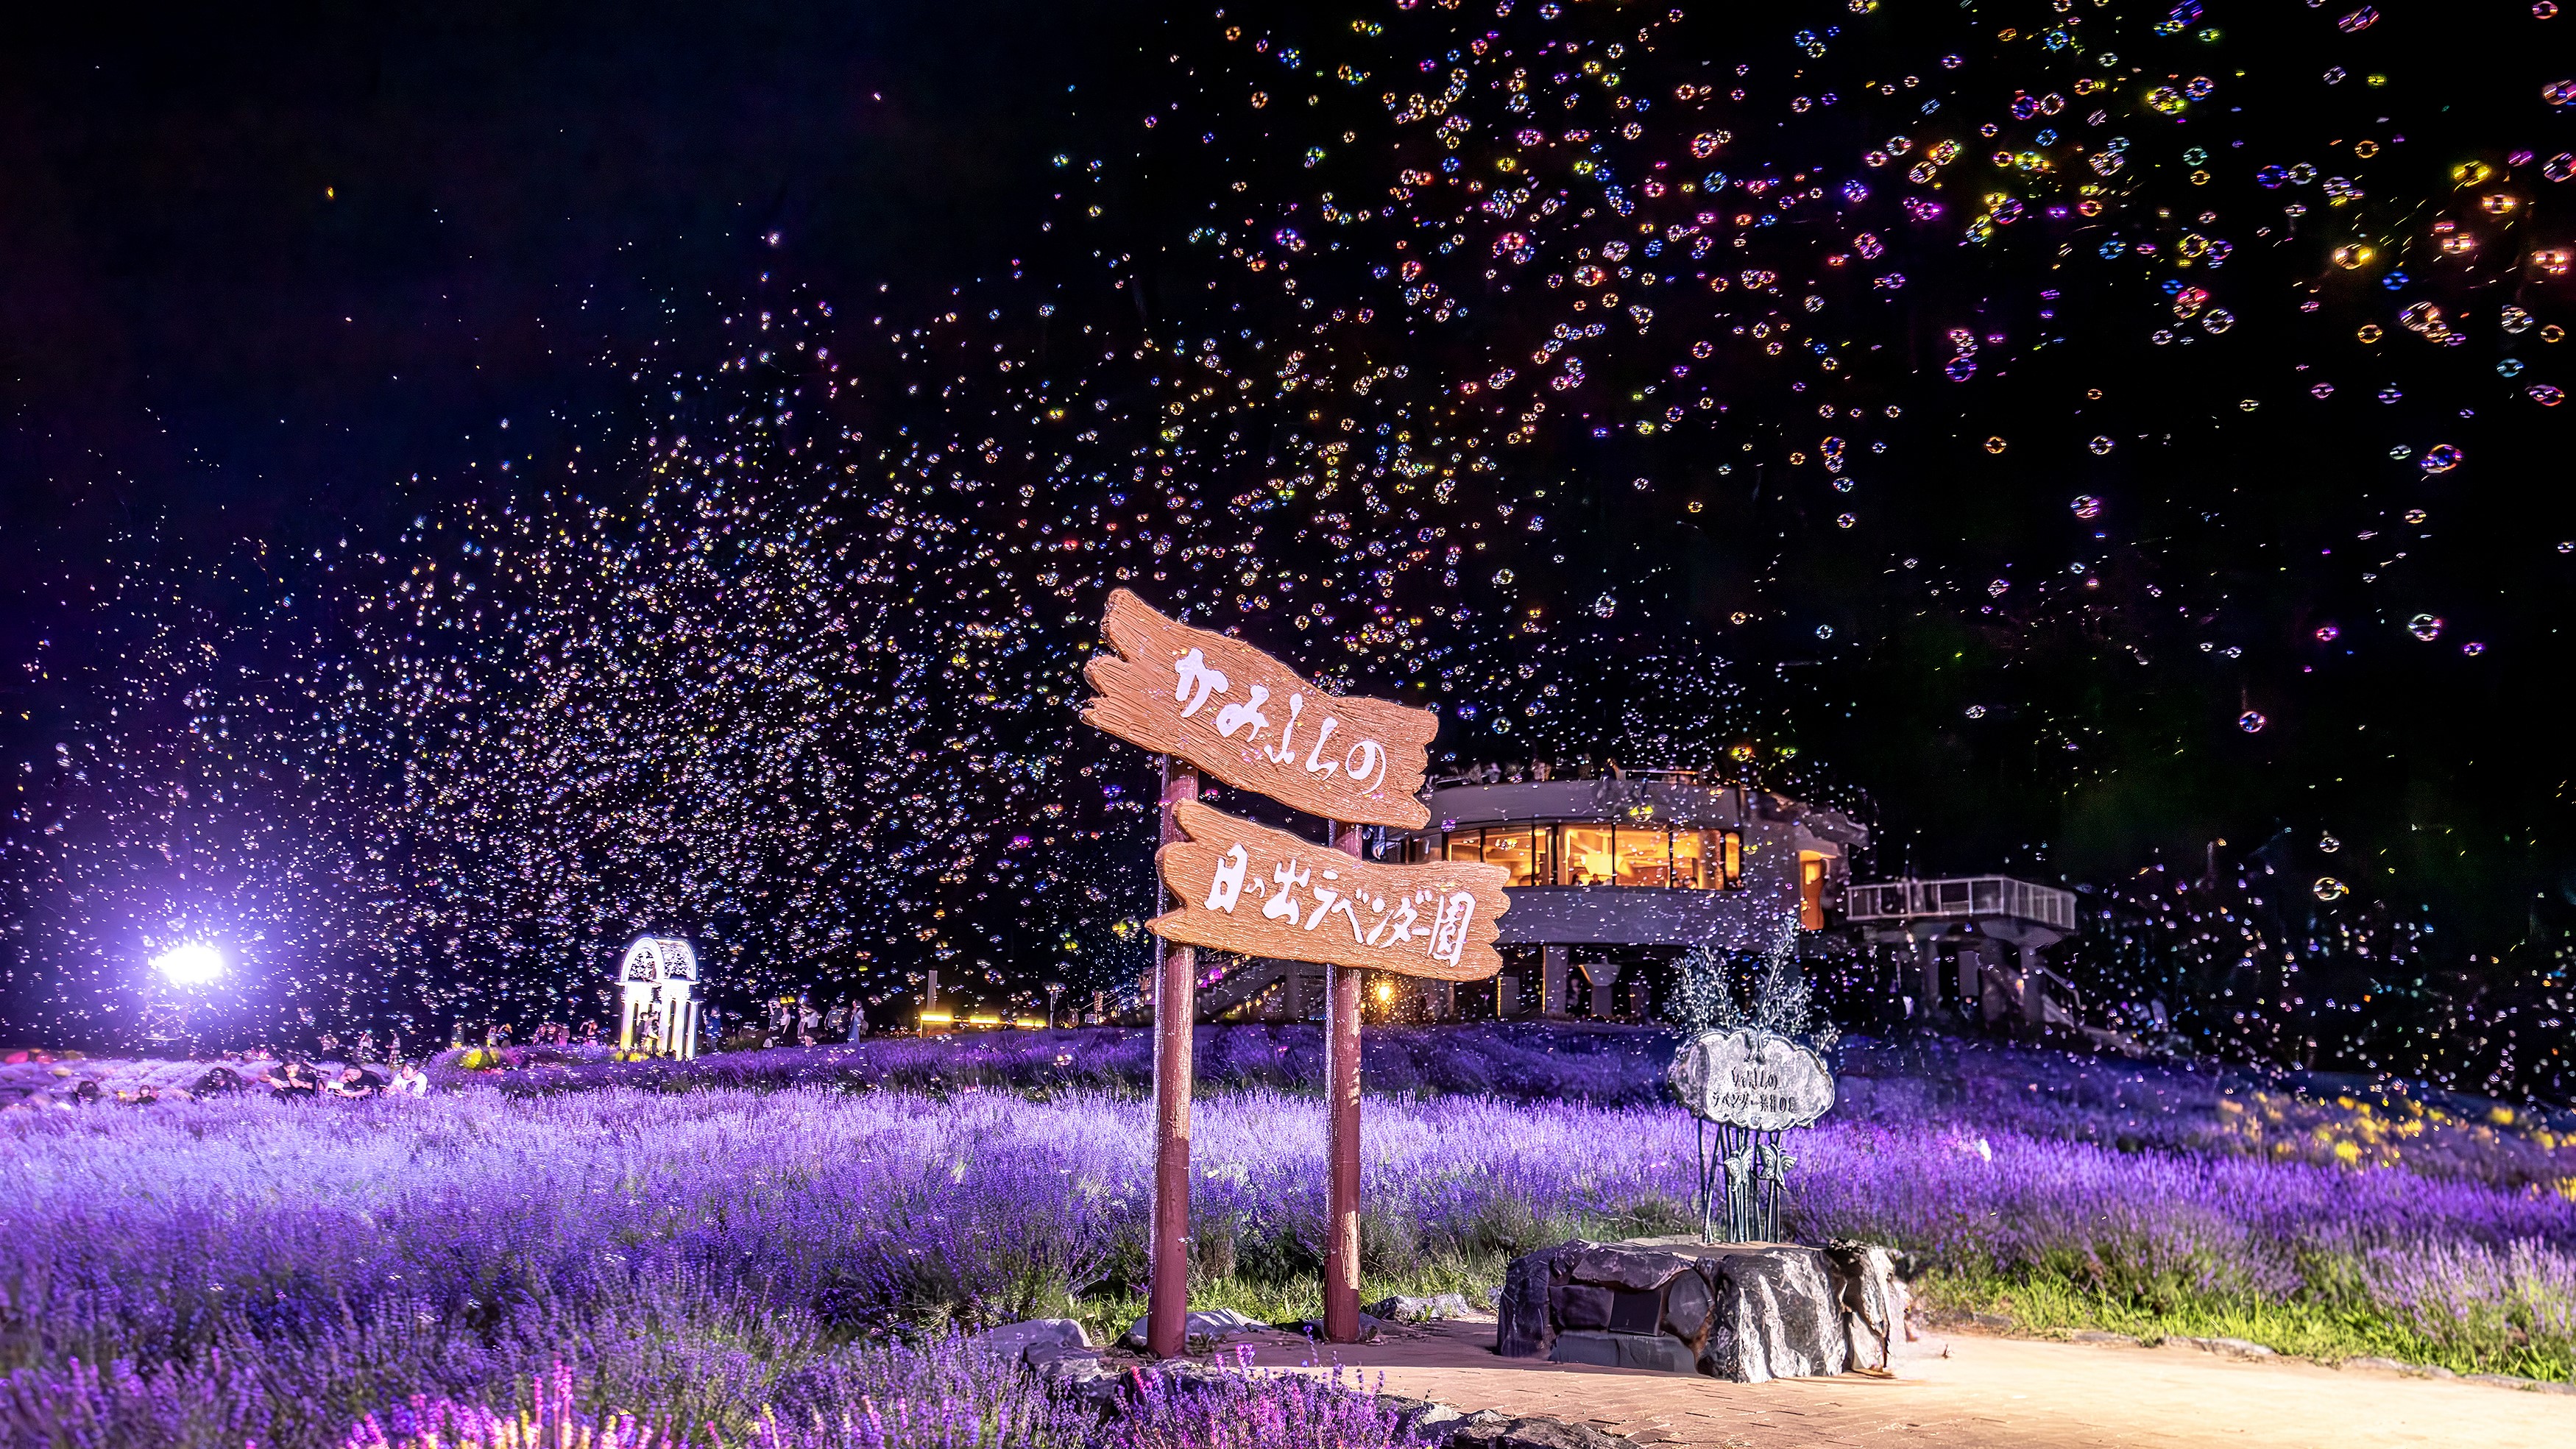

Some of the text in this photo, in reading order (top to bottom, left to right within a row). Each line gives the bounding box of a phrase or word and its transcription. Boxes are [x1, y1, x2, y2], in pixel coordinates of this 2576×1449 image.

[1175, 647, 1387, 796] かみふらの
[1203, 843, 1476, 968] 日の出ラベンダー園
